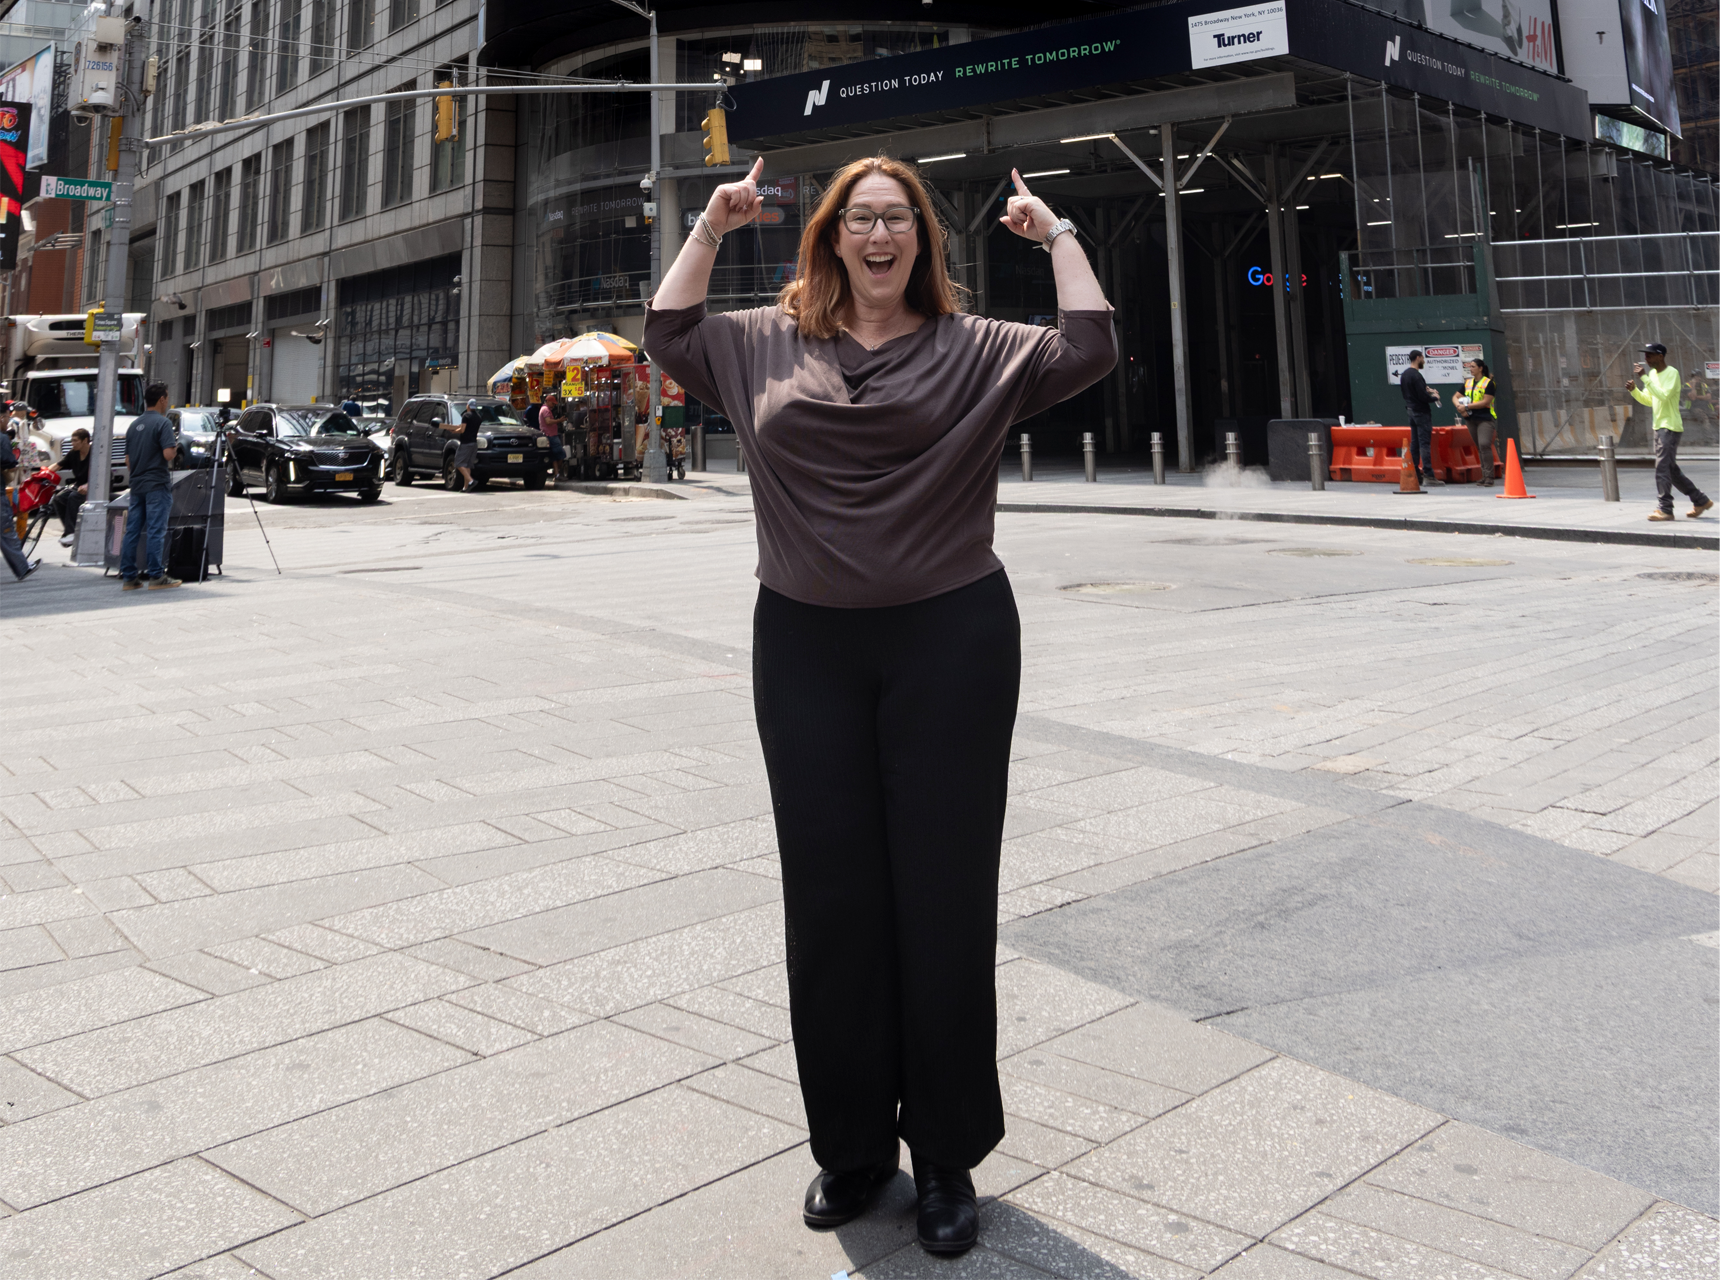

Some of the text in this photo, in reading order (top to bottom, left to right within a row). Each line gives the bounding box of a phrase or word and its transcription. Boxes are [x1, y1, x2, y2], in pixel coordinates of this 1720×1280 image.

[1204, 17, 1229, 26] Broadway
[1244, 12, 1257, 20] York,
[1267, 6, 1283, 15] 10036
[1213, 30, 1262, 48] Turner
[1525, 15, 1553, 69] H&M
[86, 60, 113, 71] 726156
[1407, 50, 1442, 70] QUESTION
[1444, 62, 1465, 78] TODAY
[1470, 70, 1500, 90] REWRITE
[839, 78, 899, 98] QUESTION
[904, 71, 944, 87] TODAY
[955, 58, 1020, 78] REWRITE
[57, 181, 109, 201] Broadway
[755, 185, 782, 196] sdaq
[601, 276, 629, 289] Nasdaq
